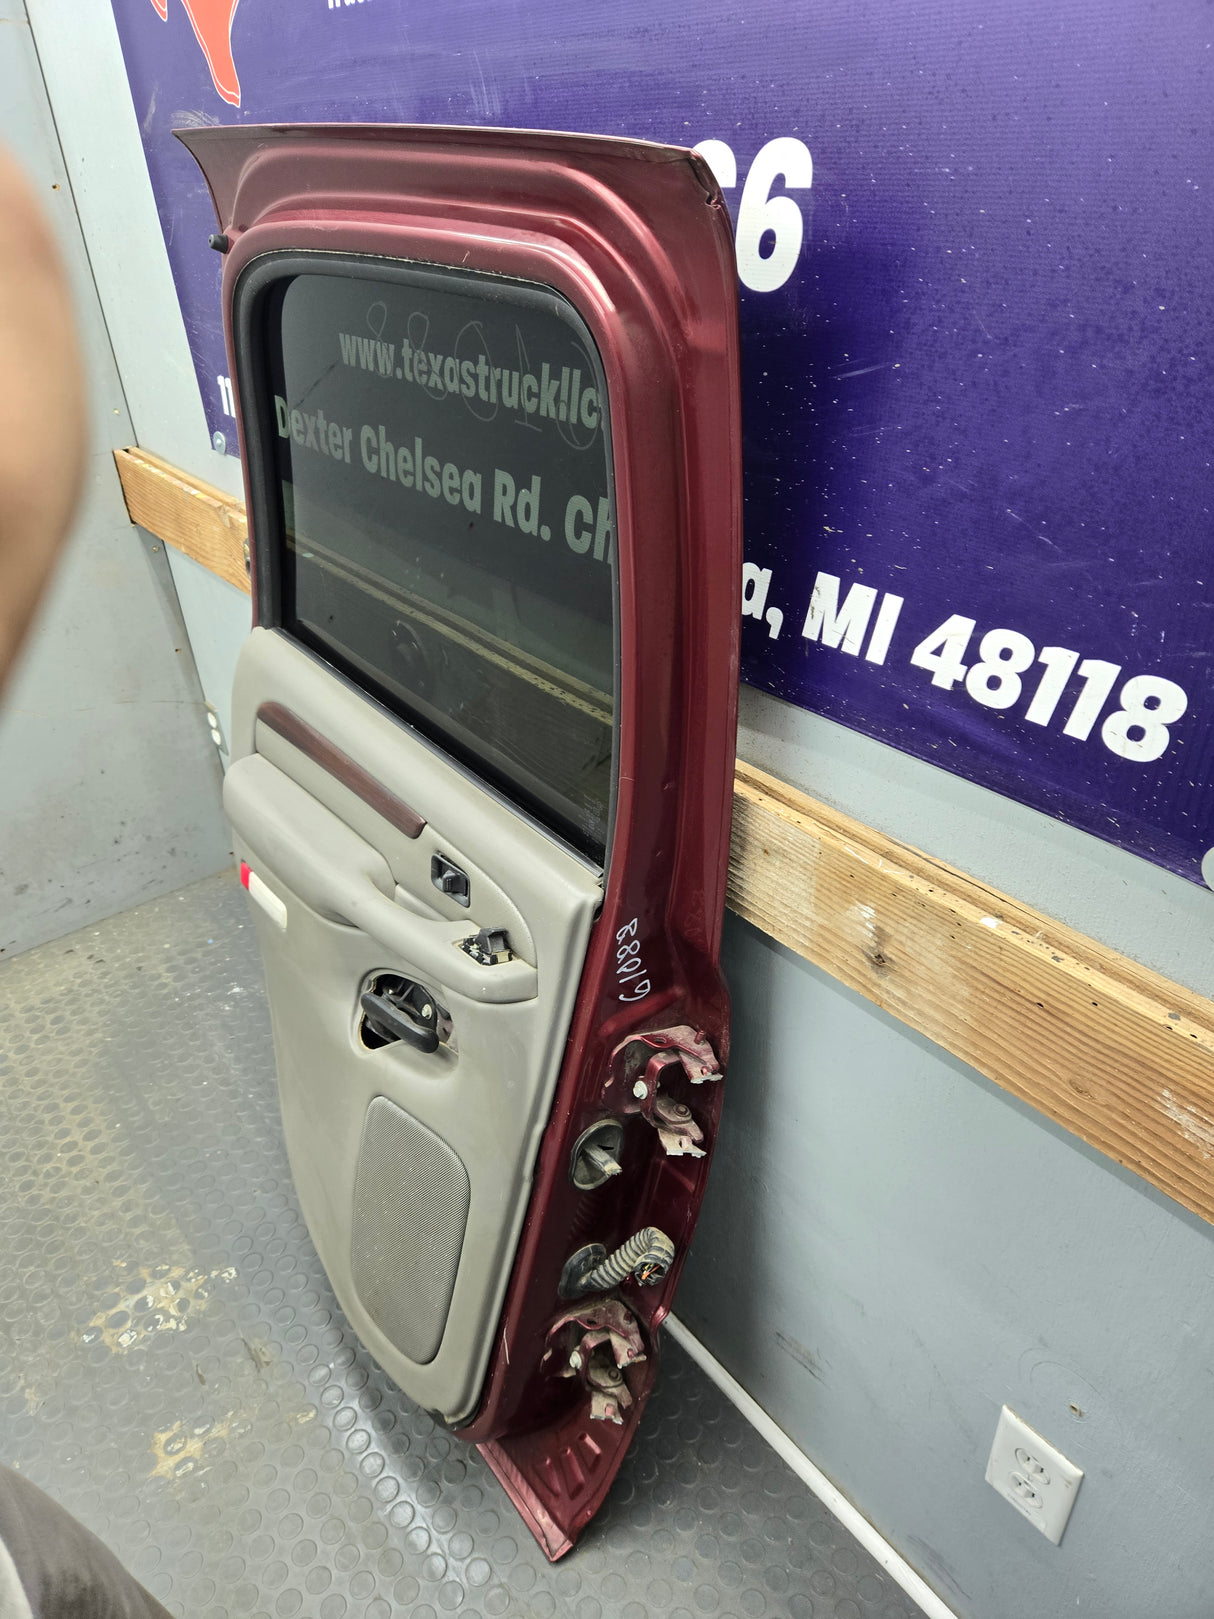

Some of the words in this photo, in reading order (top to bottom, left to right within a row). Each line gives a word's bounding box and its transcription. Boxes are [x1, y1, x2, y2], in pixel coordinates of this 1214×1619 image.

[274, 395, 353, 464] Dexter
[360, 425, 482, 514] Chelsea
[493, 468, 552, 542] Rd.
[801, 571, 905, 666] MI
[910, 613, 1189, 762] 48118
